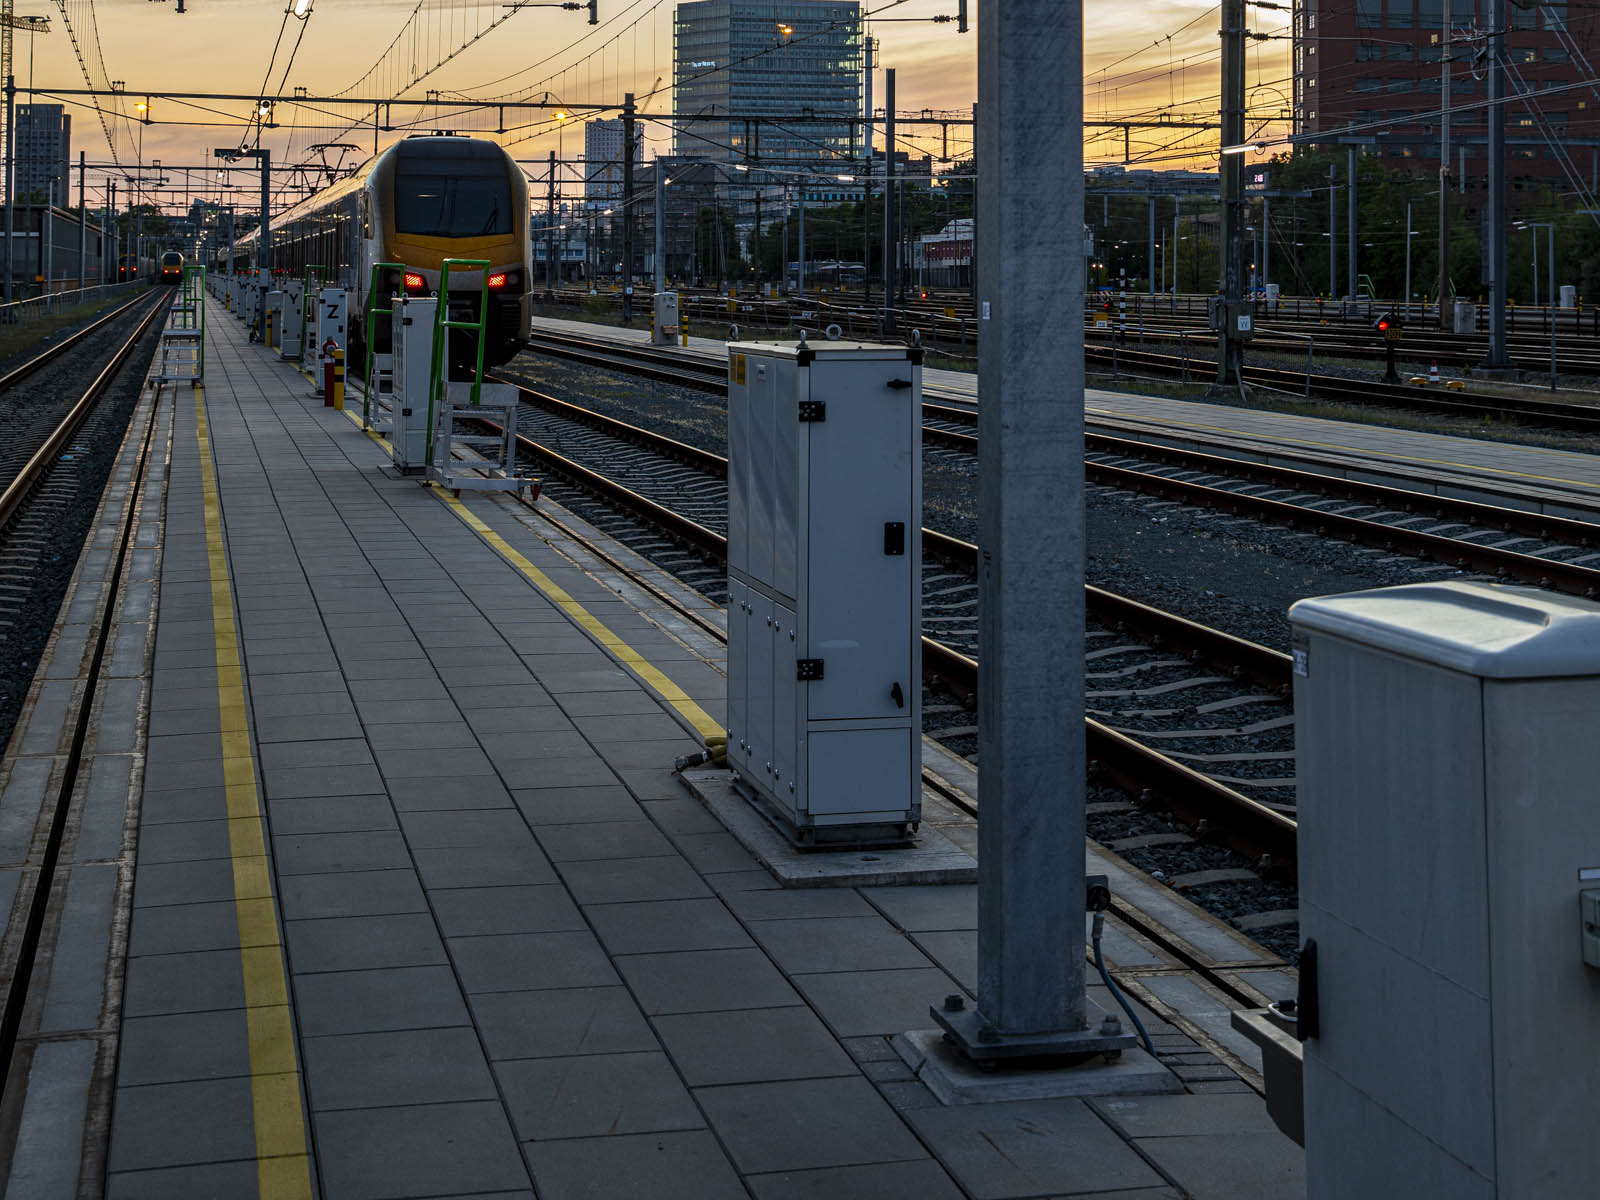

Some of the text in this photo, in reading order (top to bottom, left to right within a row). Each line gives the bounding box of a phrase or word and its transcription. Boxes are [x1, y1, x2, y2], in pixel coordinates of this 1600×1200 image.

[251, 284, 257, 292] X
[289, 293, 298, 304] Y
[327, 304, 339, 319] Z
